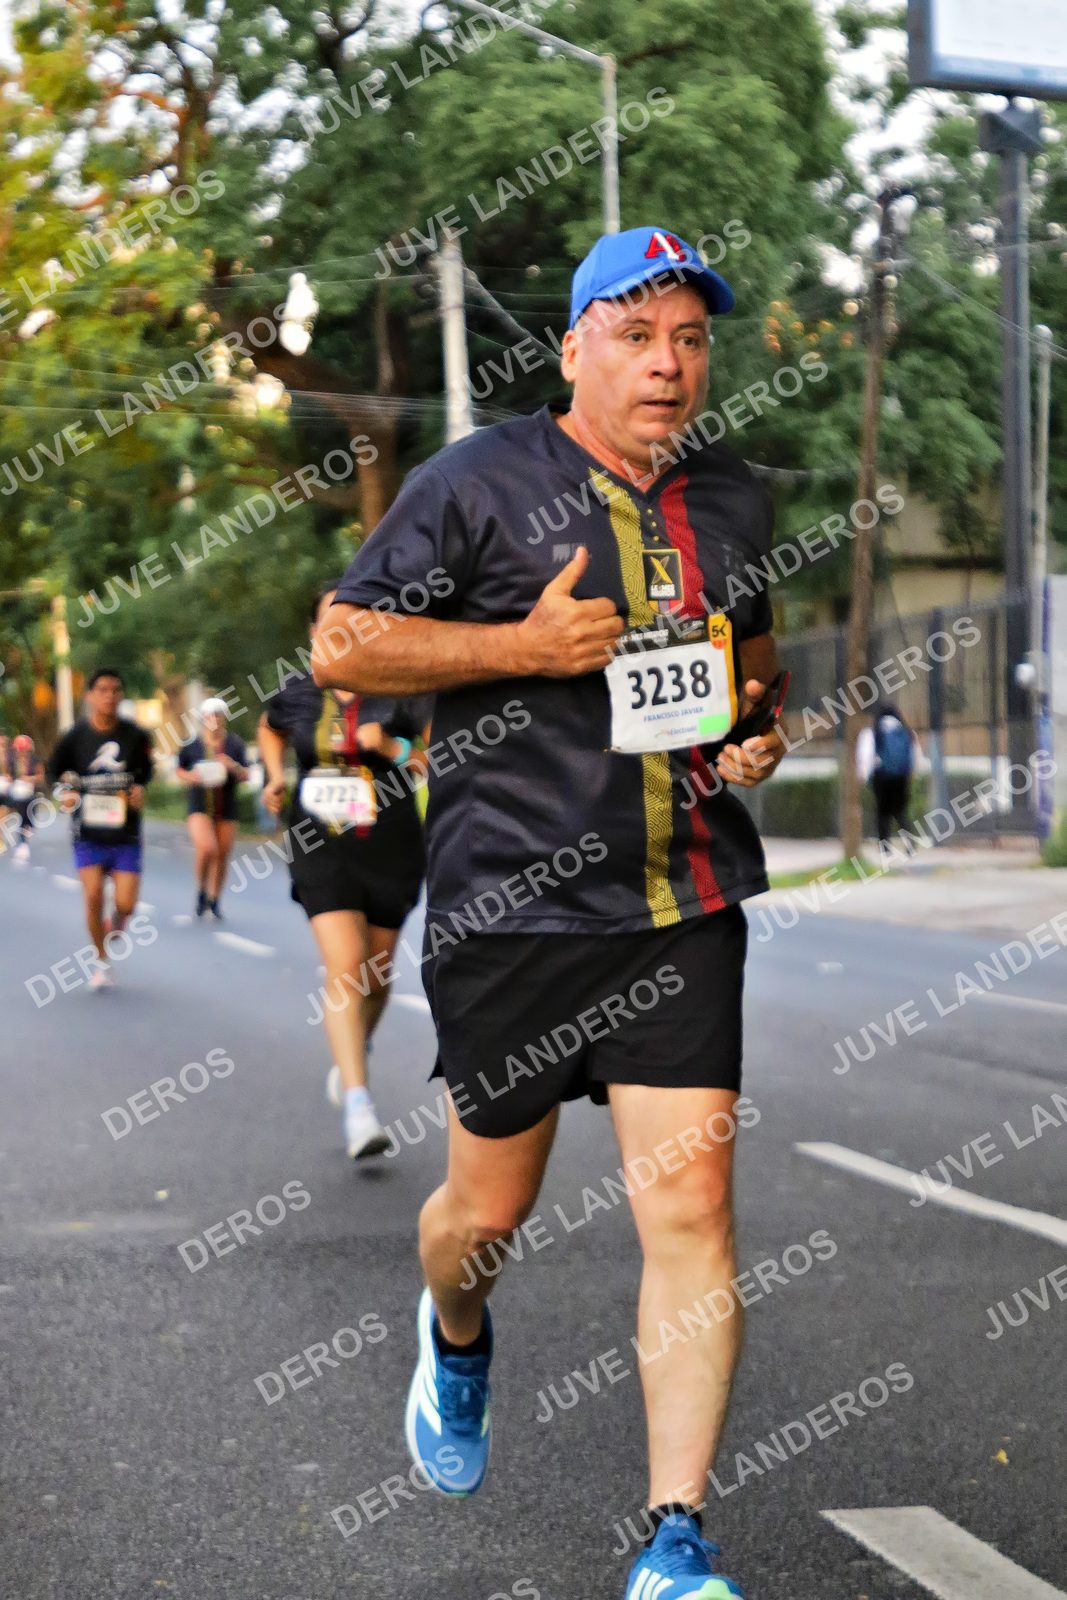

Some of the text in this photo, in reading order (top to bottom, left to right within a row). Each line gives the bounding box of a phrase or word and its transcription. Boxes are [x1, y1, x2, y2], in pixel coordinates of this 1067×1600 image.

[711, 624, 727, 639] 5K
[627, 659, 712, 710] 3238
[643, 706, 704, 722] FRANCISCO JAVIER
